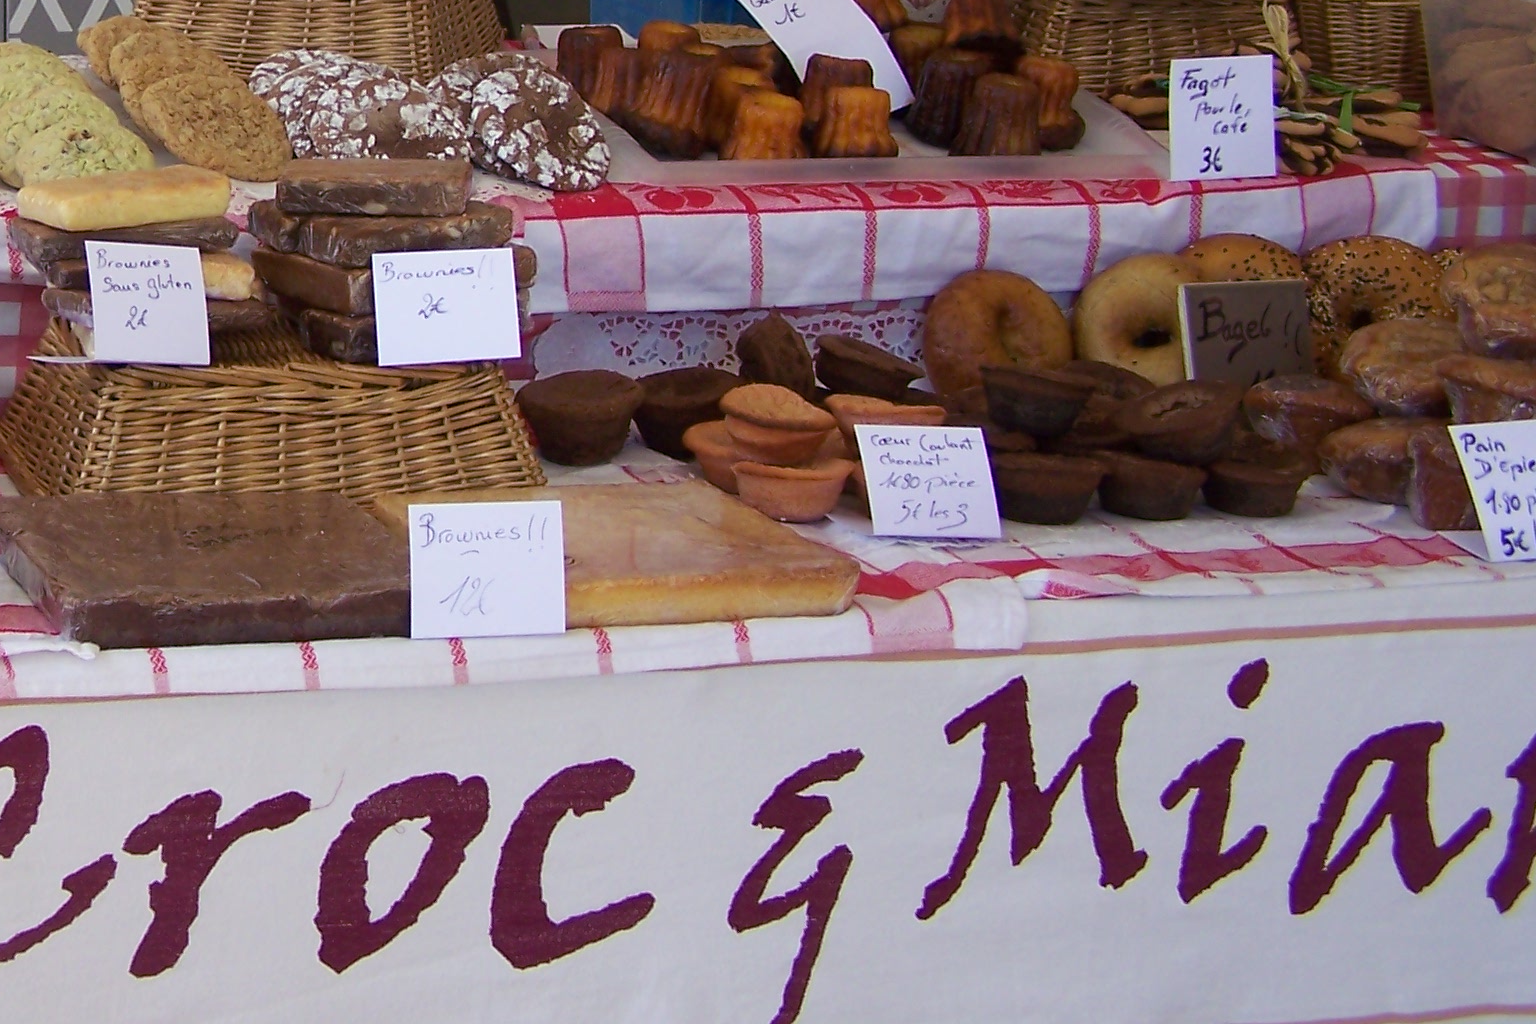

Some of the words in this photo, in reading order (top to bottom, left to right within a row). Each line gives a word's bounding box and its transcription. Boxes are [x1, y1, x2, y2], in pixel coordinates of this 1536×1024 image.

[1180, 66, 1236, 101] Fagot
[1199, 145, 1223, 174] 3€
[96, 248, 171, 269] Brownies
[147, 273, 193, 299] gluten
[1459, 432, 1506, 454] Pain
